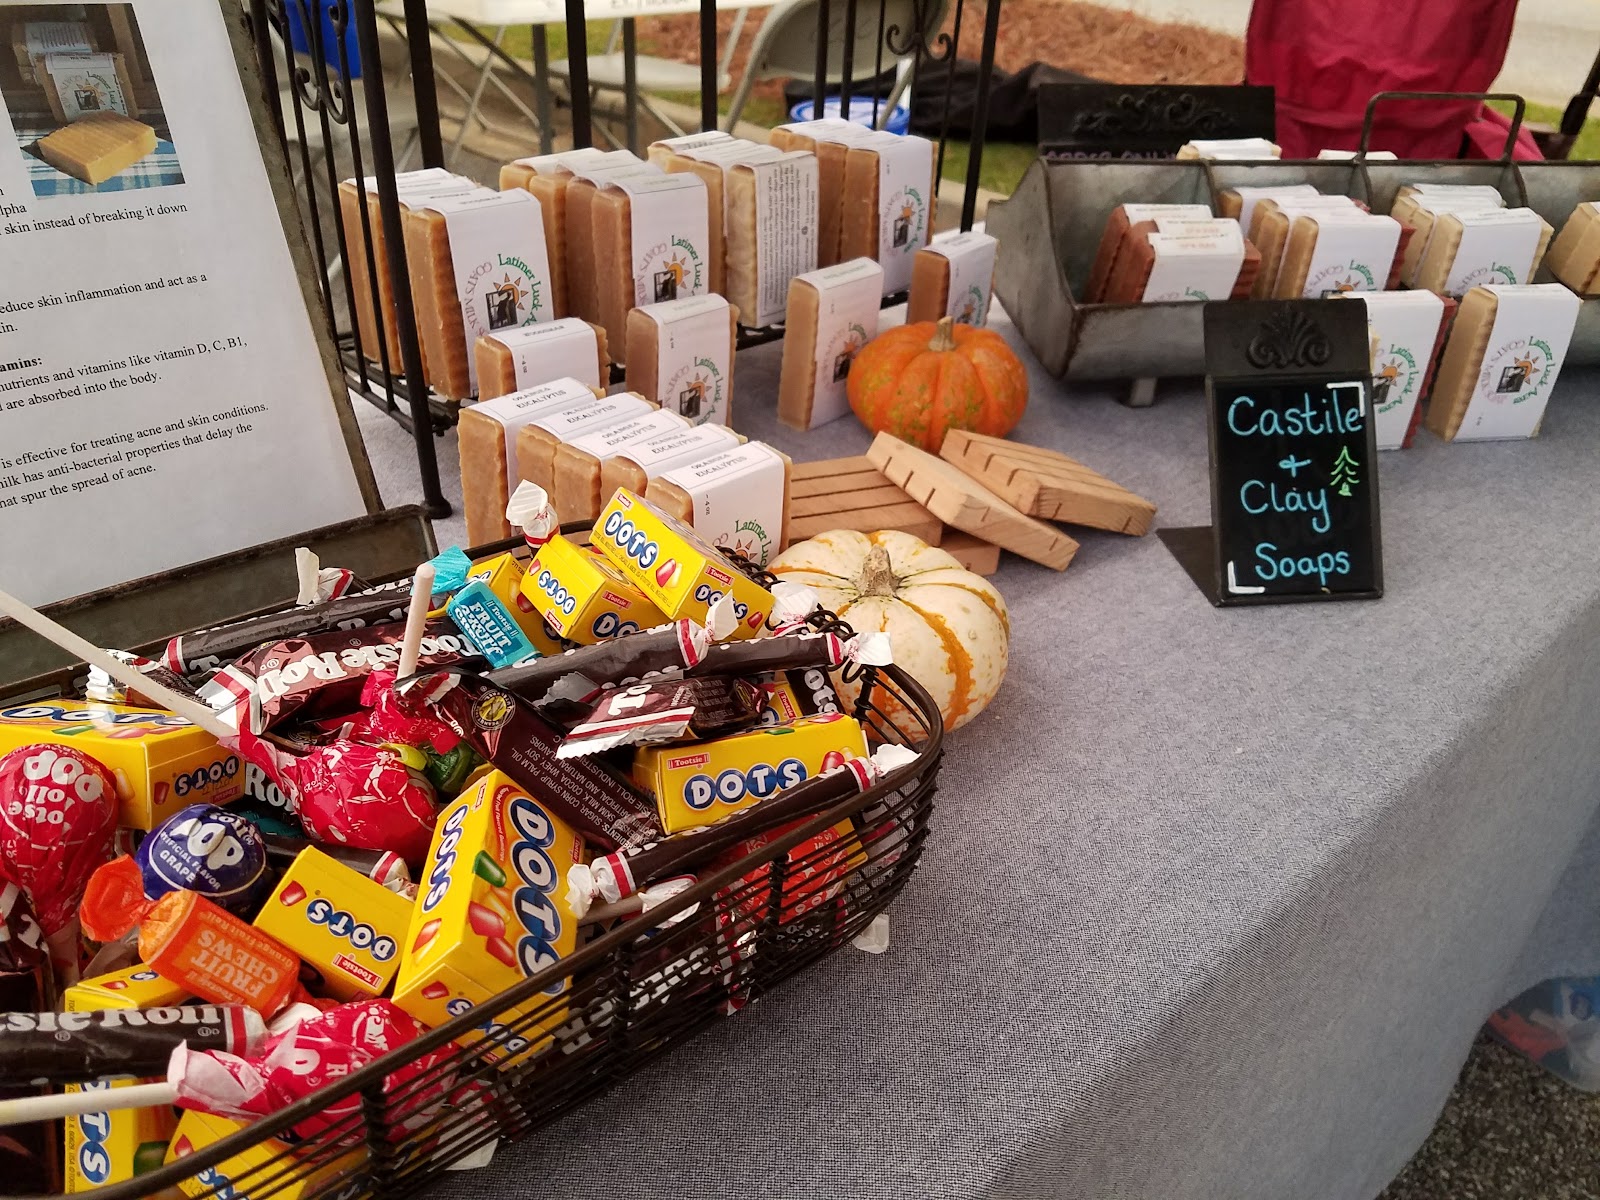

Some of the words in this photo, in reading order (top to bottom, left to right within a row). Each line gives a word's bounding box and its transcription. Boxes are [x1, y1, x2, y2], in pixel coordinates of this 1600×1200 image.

[4, 222, 31, 236] skin
[33, 216, 76, 231] instead
[78, 213, 91, 225] of
[92, 208, 145, 225] breaking
[145, 205, 154, 217] it
[156, 202, 188, 216] down
[671, 235, 699, 261] Latimer
[694, 262, 704, 290] Luck
[37, 295, 63, 308] skin
[65, 283, 142, 304] inflammation
[144, 277, 166, 291] and
[167, 275, 184, 288] act
[186, 274, 198, 284] as
[200, 273, 208, 282] a
[497, 253, 536, 281] Latimer
[531, 280, 543, 312] Luck
[53, 368, 75, 383] and
[77, 358, 127, 377] vitamins
[128, 354, 152, 368] like
[153, 346, 195, 362] vitamin
[197, 342, 211, 355] D,
[212, 340, 226, 352] C,
[227, 335, 248, 350] B1,
[6, 398, 25, 411] are
[28, 386, 82, 406] absorbed
[84, 380, 107, 395] into
[109, 376, 128, 389] the
[130, 371, 162, 387] body.
[693, 355, 720, 380] Latimer
[712, 377, 724, 405] Luck
[516, 389, 567, 410] EUCALYPTUS
[566, 404, 617, 424] EUCALYPTUS
[1227, 388, 1363, 437] Castile
[1, 457, 13, 470] is
[15, 446, 68, 467] effective
[70, 441, 88, 454] for
[90, 430, 135, 450] treating
[136, 427, 163, 440] acne
[164, 419, 185, 433] and
[187, 413, 211, 428] skin
[212, 402, 269, 423] conditions.
[606, 424, 657, 446] EUCALYPTUS
[652, 435, 703, 454] EUCALYPTUS
[23, 469, 45, 484] has
[47, 450, 123, 478] anti-bacterial
[125, 438, 181, 463] properties
[182, 432, 204, 447] that
[206, 426, 234, 442] delay
[235, 422, 253, 435] the
[695, 455, 747, 478] EUCALYPTUS
[20, 490, 48, 506] spur
[49, 480, 69, 496] the
[71, 473, 110, 493] spread
[112, 468, 125, 481] of
[126, 463, 157, 478] acne.
[1240, 480, 1332, 534] Clay
[603, 510, 661, 570] DOTS
[734, 518, 767, 543] Latimer
[1254, 542, 1350, 586] Soaps
[538, 569, 577, 616] DOTS
[694, 583, 749, 620] DOS
[467, 599, 513, 650] FRUIT
[490, 604, 514, 631] Tootsie
[341, 634, 479, 672] Toosie
[256, 651, 348, 705] Roll
[507, 747, 523, 762] OIL,
[519, 757, 541, 776] PALM
[524, 745, 541, 761] SOY
[537, 756, 561, 777] WHEY,
[674, 756, 703, 767] Tootsie
[175, 755, 241, 797] DOTS
[538, 771, 563, 794] SYRUP,
[557, 772, 583, 796] COCOA,
[583, 779, 601, 795] AND
[683, 757, 808, 811] DOTS
[559, 788, 581, 808] CORN
[579, 790, 601, 810] MILK,
[597, 790, 631, 821] ARTIFICIAL
[612, 783, 636, 805] ROLL
[577, 802, 603, 826] SUGAR,
[596, 804, 616, 823] SKIM
[599, 820, 635, 852] REDIENTS:
[158, 848, 197, 883] GRAPE
[191, 859, 221, 890] FLAVOR
[421, 804, 469, 914] DOTS
[510, 797, 566, 996] DOTS
[305, 897, 398, 963] DOTS
[189, 948, 265, 998] FRUIT
[196, 929, 278, 983] CHEWS
[341, 959, 374, 983] Tootsie
